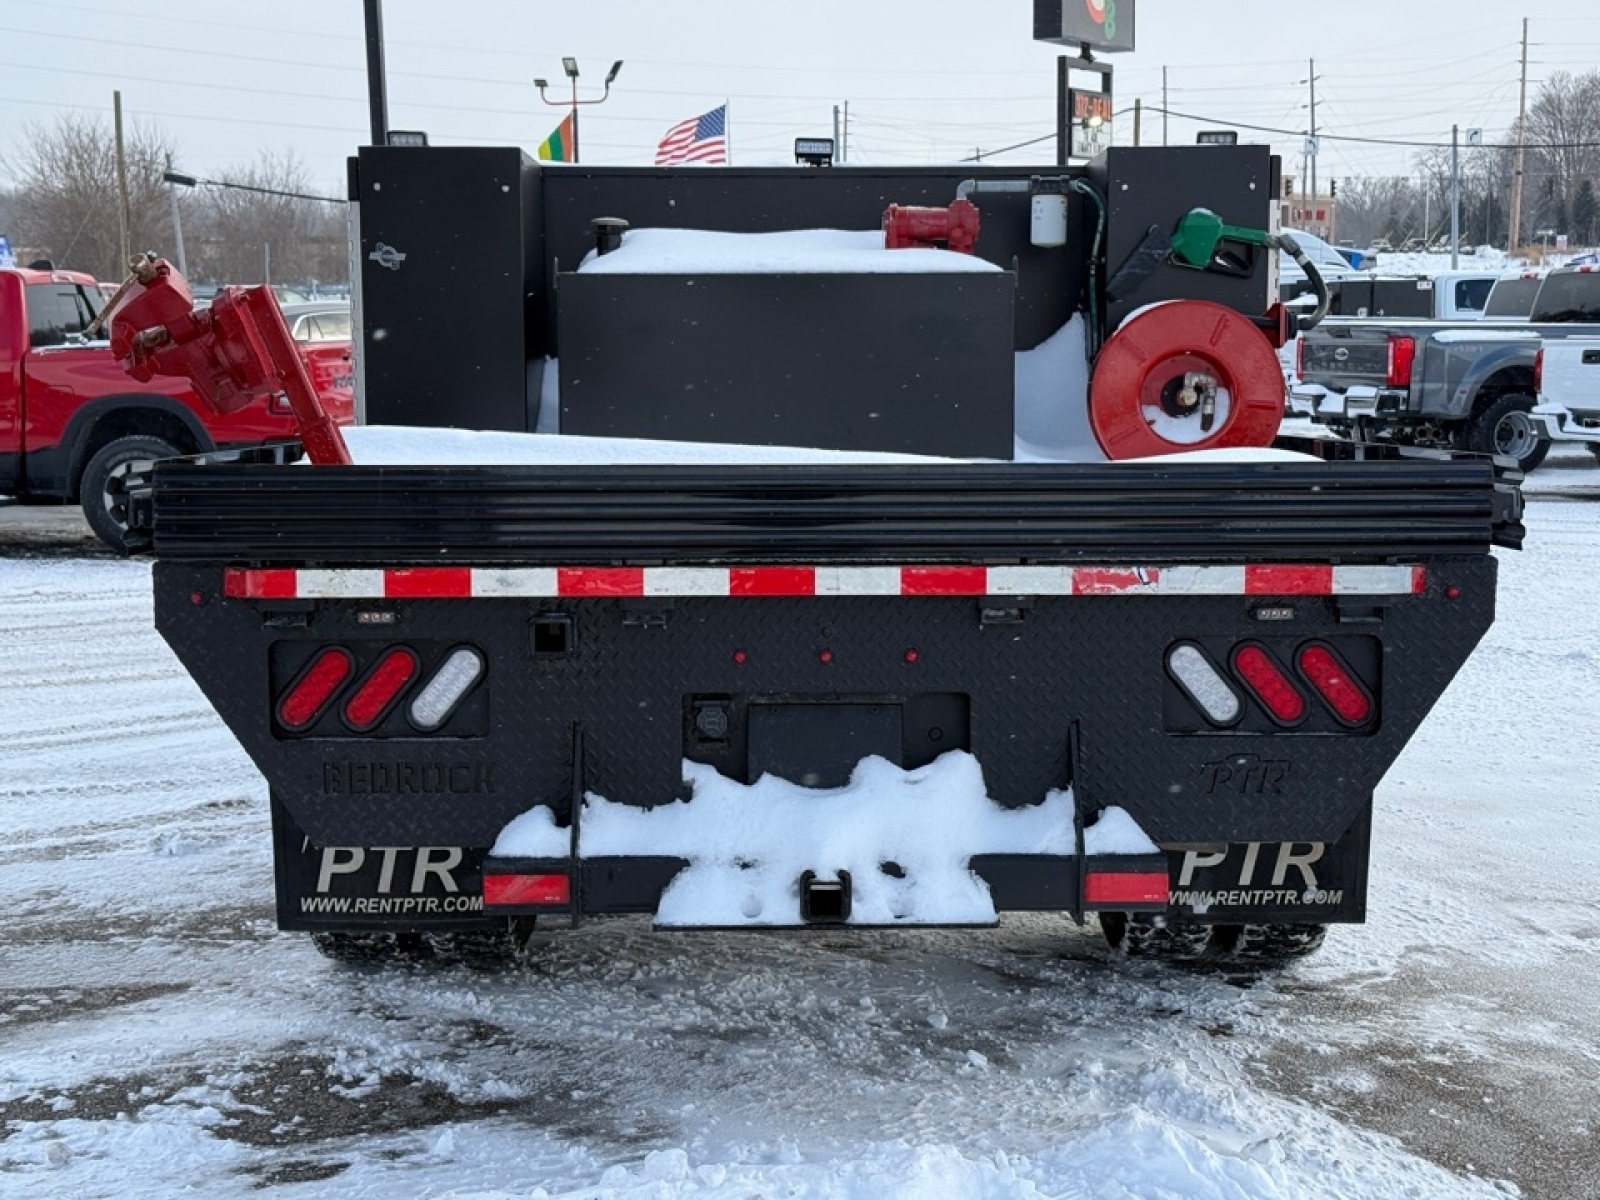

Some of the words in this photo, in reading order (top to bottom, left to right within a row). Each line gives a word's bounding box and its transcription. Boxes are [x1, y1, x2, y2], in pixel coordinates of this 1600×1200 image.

[322, 761, 496, 794] BEDROCK
[1200, 753, 1292, 794] PTR
[316, 846, 463, 893] PTR
[1177, 841, 1326, 886] PTR
[301, 896, 484, 913] WWW.RENTPTR.COM
